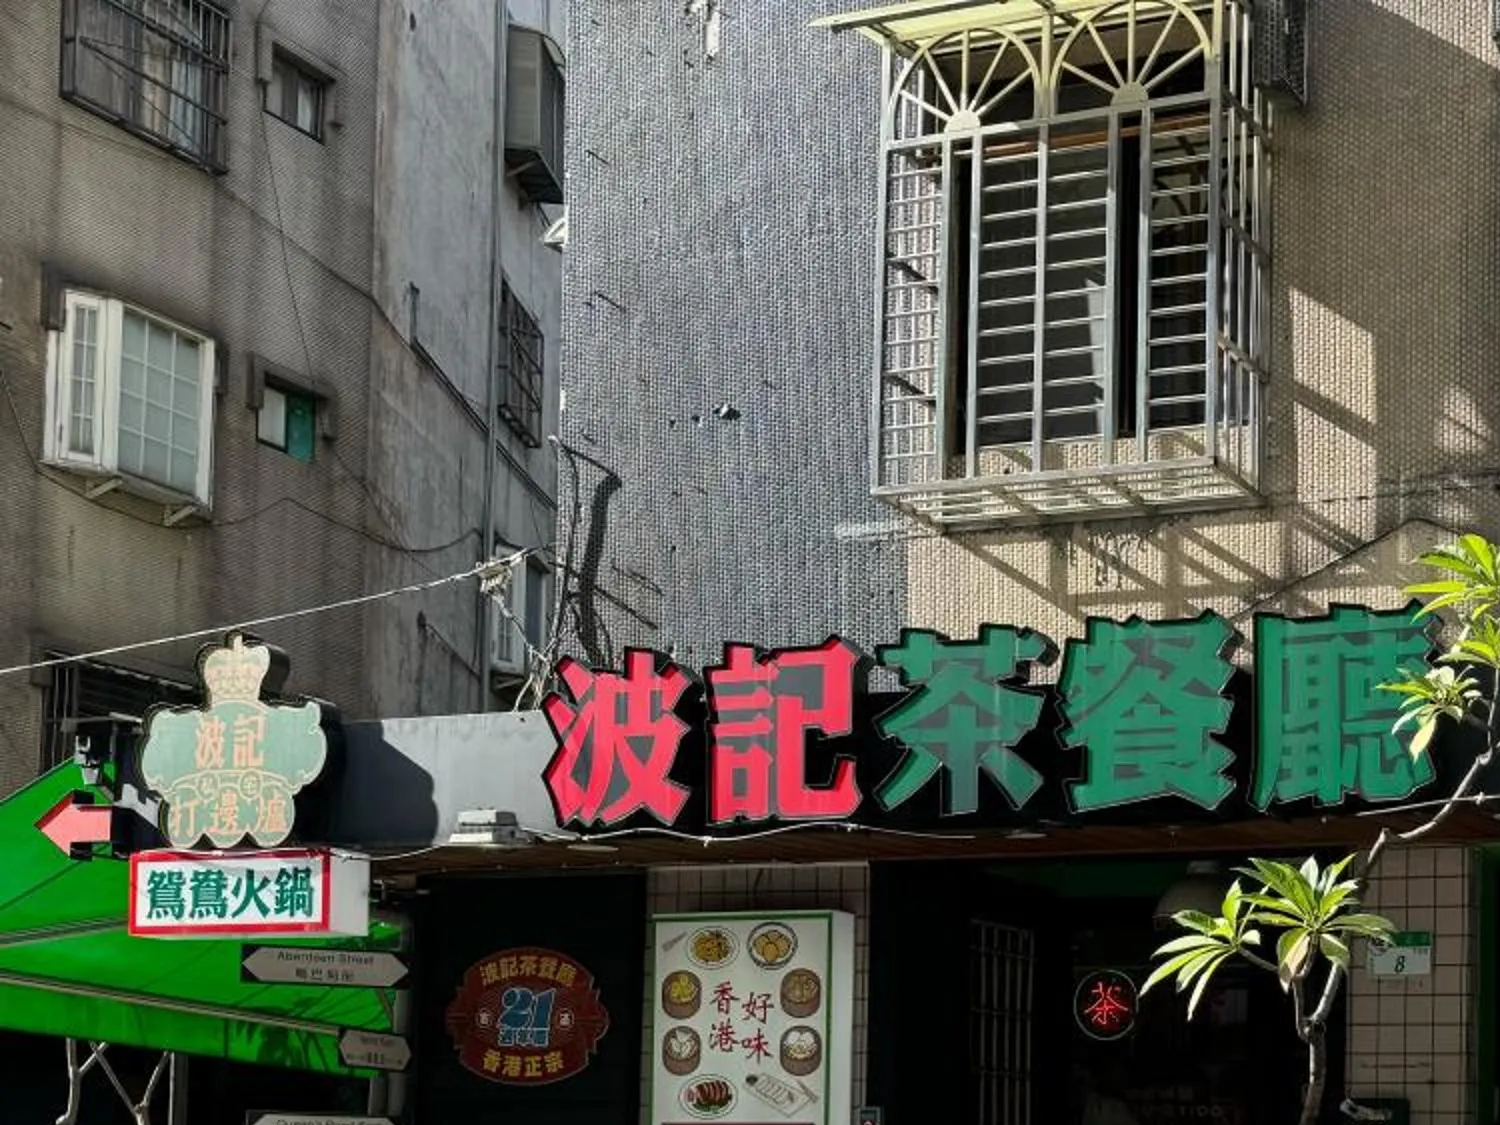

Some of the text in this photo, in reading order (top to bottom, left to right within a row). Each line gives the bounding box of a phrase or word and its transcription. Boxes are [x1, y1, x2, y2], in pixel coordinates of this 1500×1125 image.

[195, 713, 268, 769] 波記
[545, 603, 1440, 828] 波記茶餐廳
[146, 867, 315, 920] 鴛鴦火鍋
[339, 952, 375, 965] Street
[709, 981, 740, 1053] 香港
[741, 991, 775, 1064] 好味
